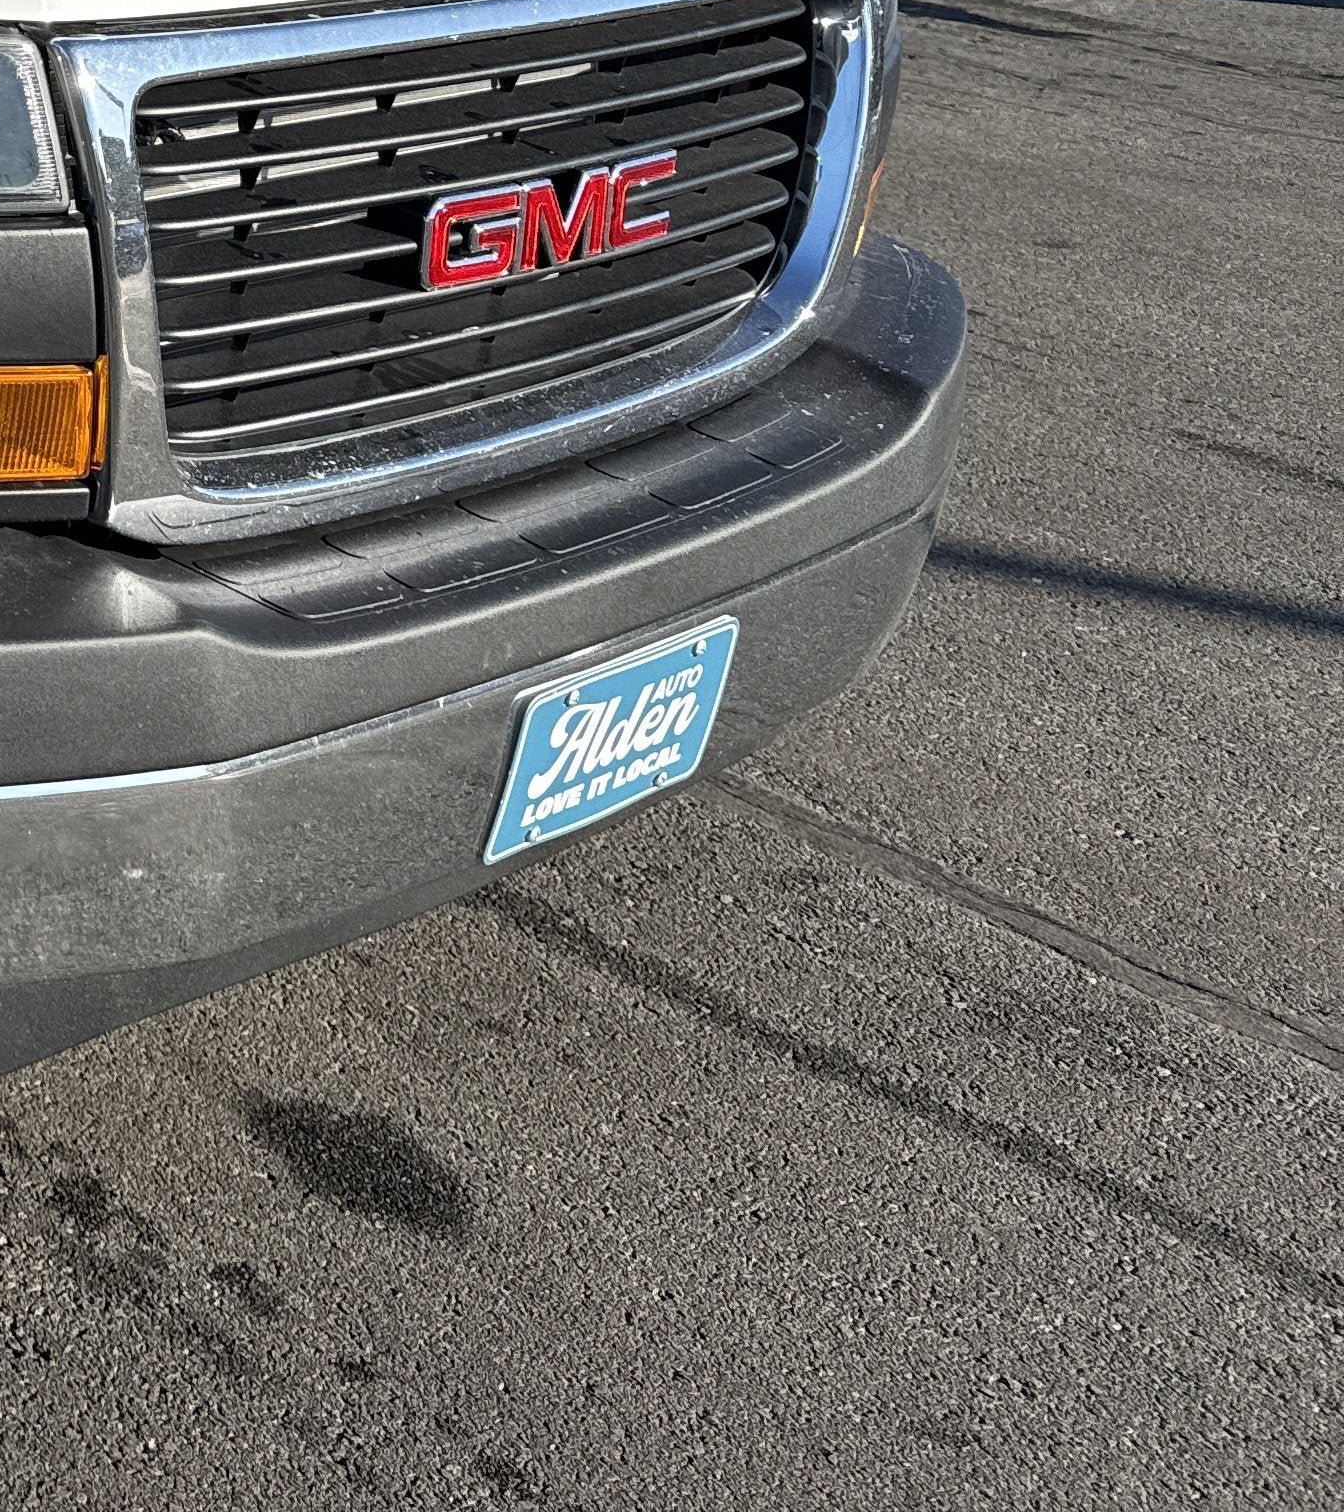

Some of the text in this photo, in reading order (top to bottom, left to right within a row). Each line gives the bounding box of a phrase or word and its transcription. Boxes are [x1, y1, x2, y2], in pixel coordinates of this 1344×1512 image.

[421, 149, 678, 291] GMC
[651, 664, 703, 703] AUTO
[520, 743, 682, 827] LOVE IT LOCAL
[527, 683, 700, 800] Alden
